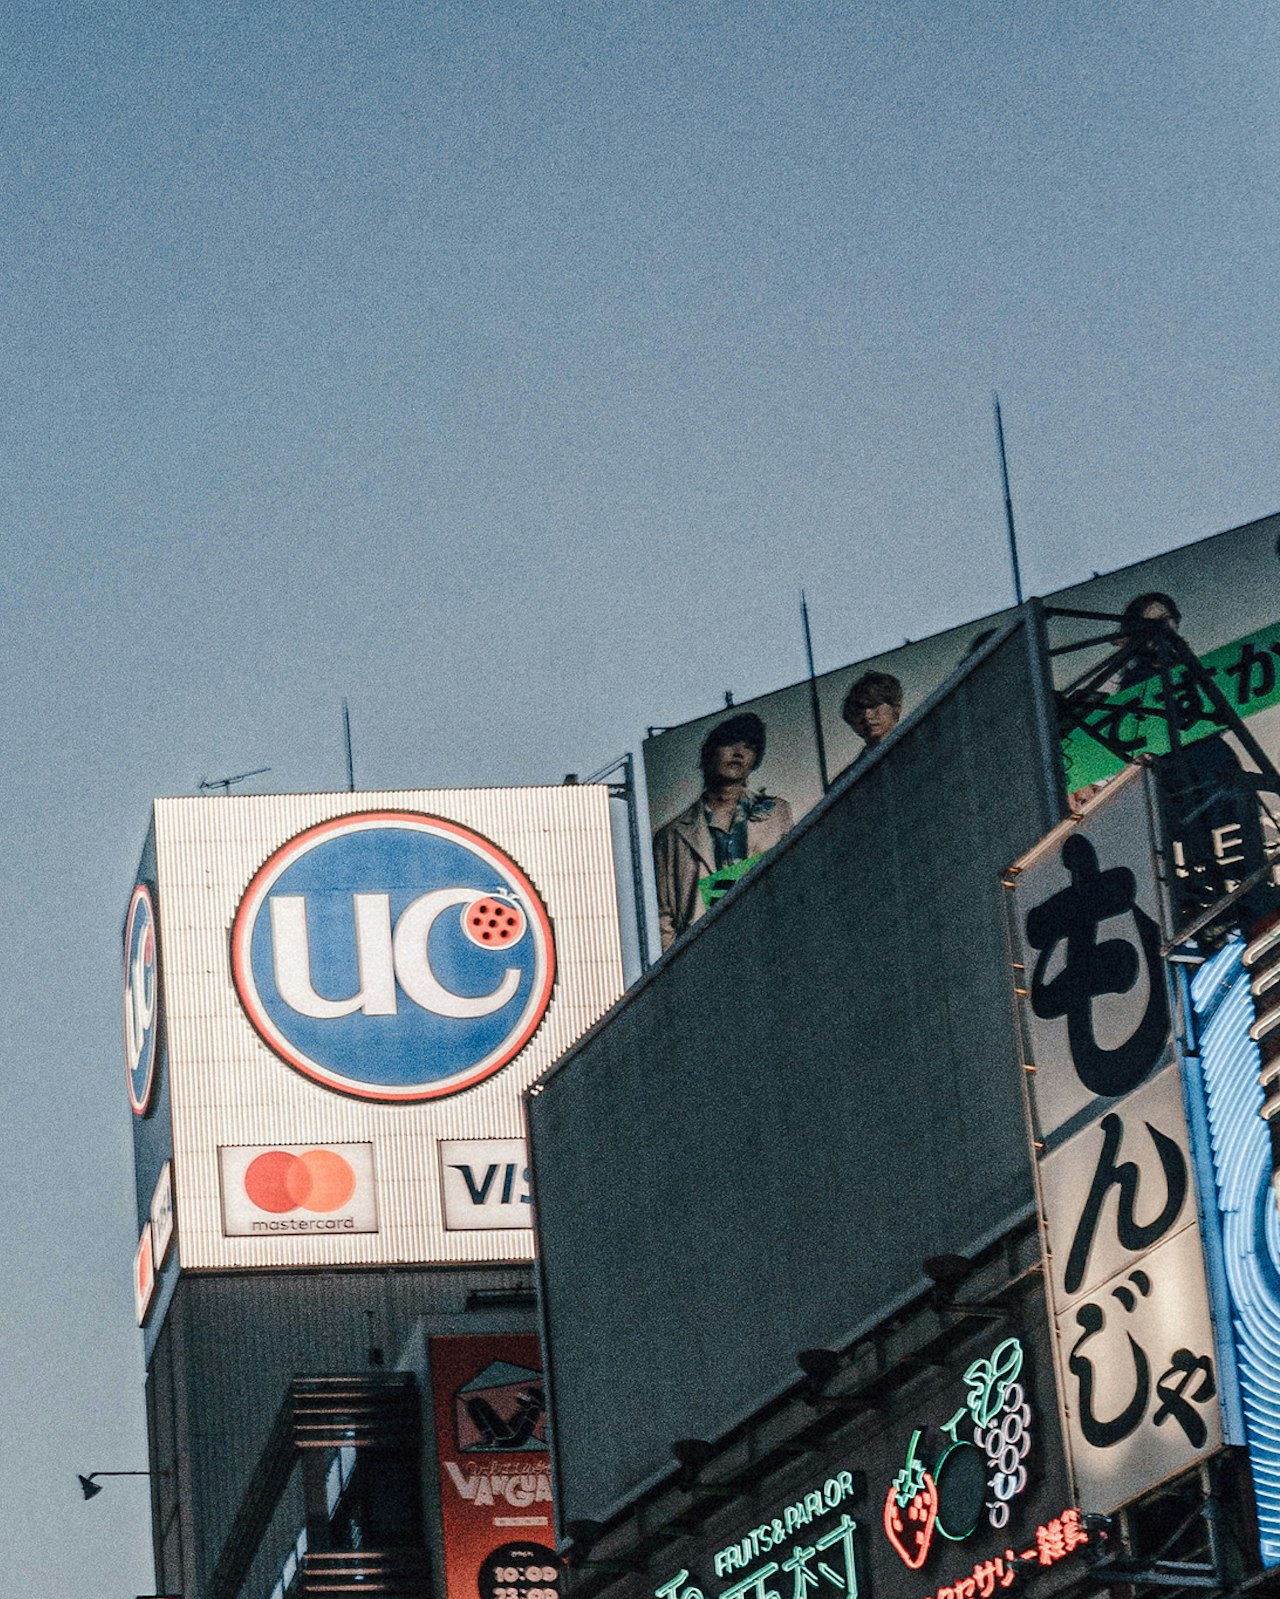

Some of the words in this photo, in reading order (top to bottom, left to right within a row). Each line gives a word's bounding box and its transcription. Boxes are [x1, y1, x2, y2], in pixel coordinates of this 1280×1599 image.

[1025, 833, 1216, 1450] もんじゃ
[251, 1214, 355, 1231] mastercard
[713, 1470, 854, 1579] FRUITS&PARLOR
[493, 1565, 559, 1583] 10:00
